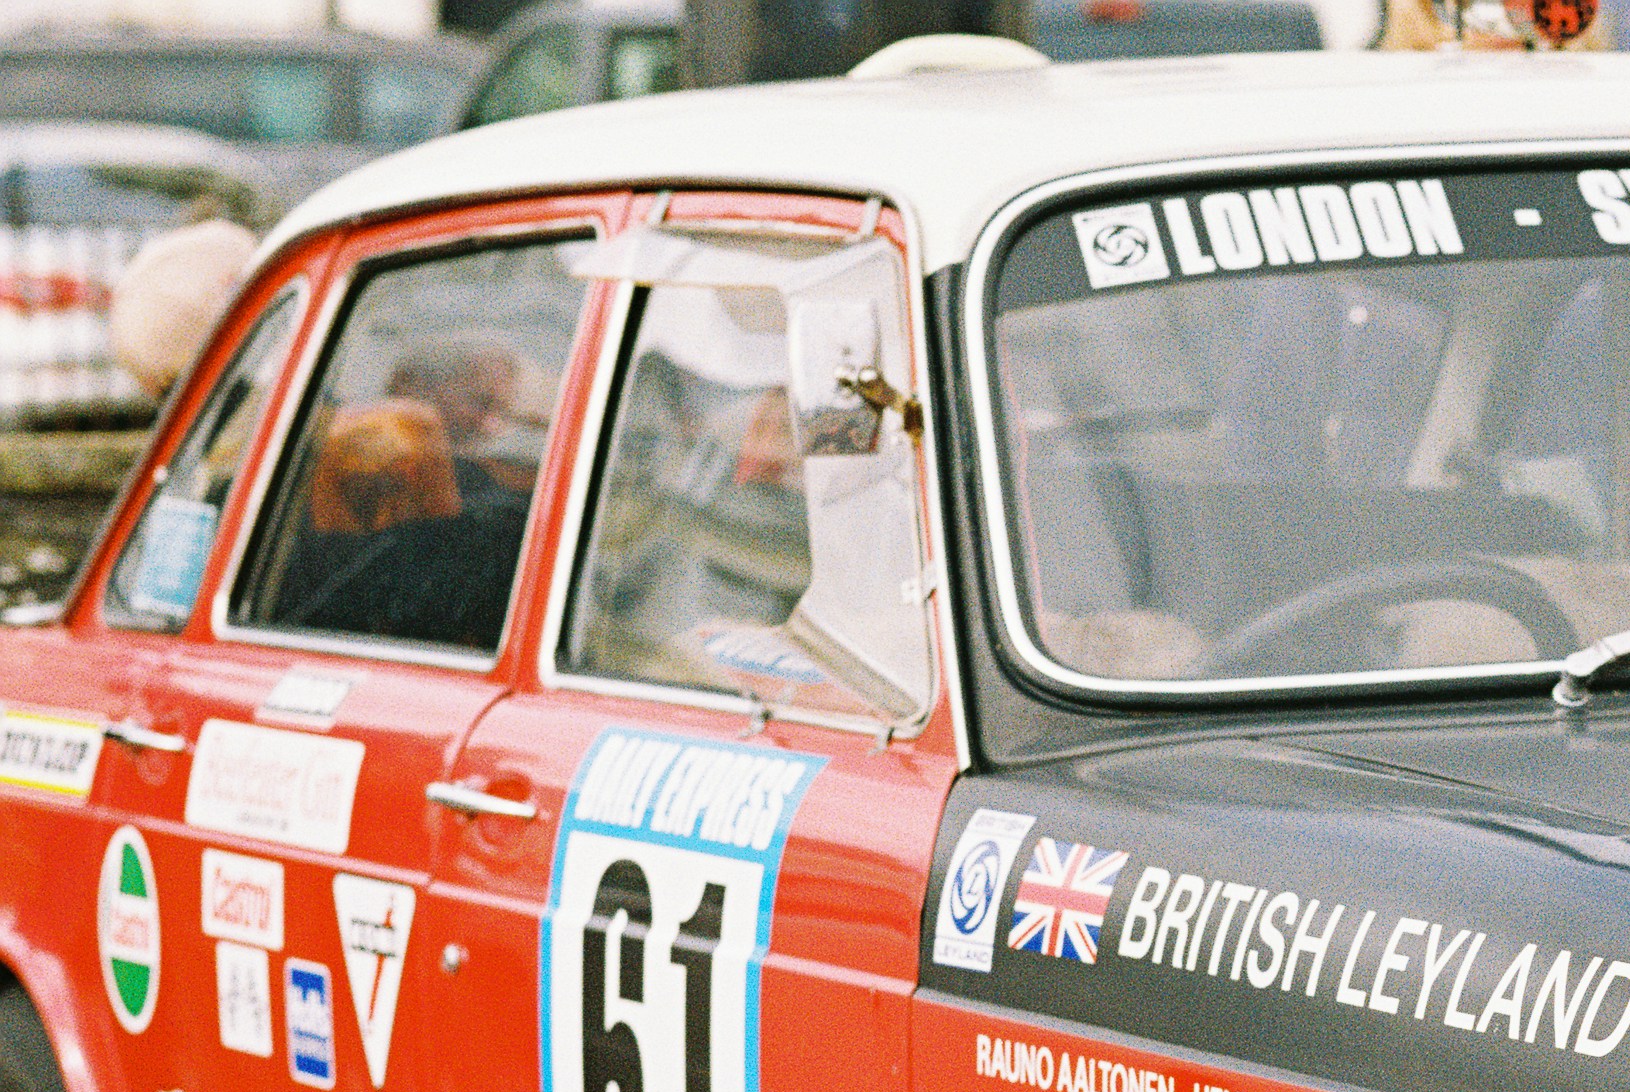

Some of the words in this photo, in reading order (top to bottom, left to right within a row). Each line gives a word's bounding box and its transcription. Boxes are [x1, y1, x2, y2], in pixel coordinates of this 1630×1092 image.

[1162, 179, 1464, 277] LONDON
[1118, 865, 1346, 998] BRITISH
[976, 1033, 1055, 1090] RAUNO
